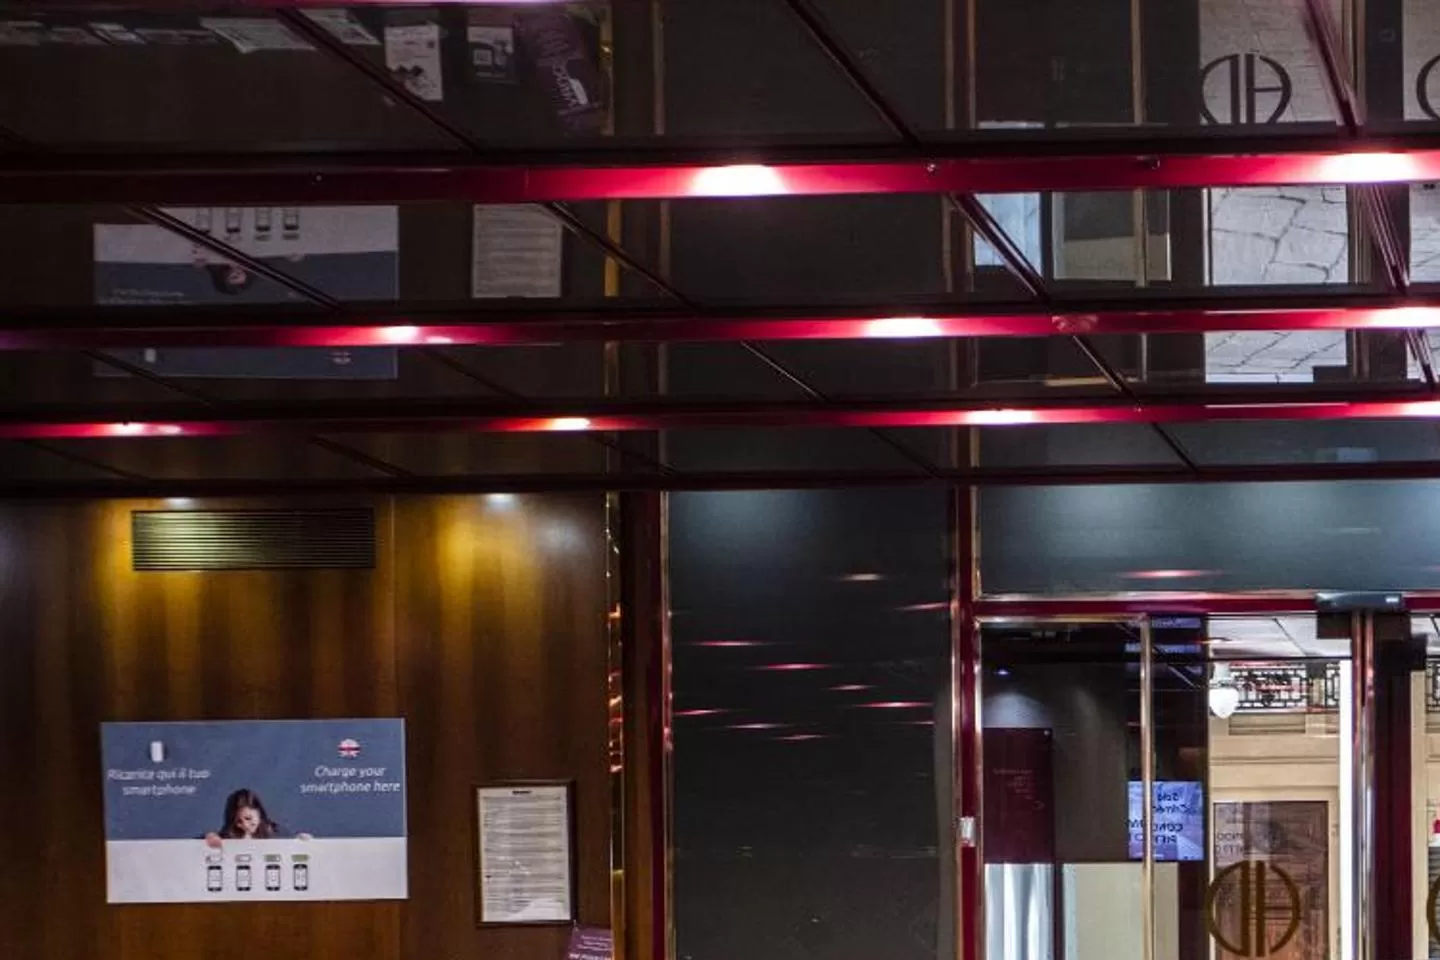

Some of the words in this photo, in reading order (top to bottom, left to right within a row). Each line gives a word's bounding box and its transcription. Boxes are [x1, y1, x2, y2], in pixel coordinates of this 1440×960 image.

[314, 765, 357, 779] Charge
[359, 766, 387, 779] your
[122, 784, 197, 797] smartphone
[299, 780, 371, 795] smartphone
[372, 779, 400, 793] here
